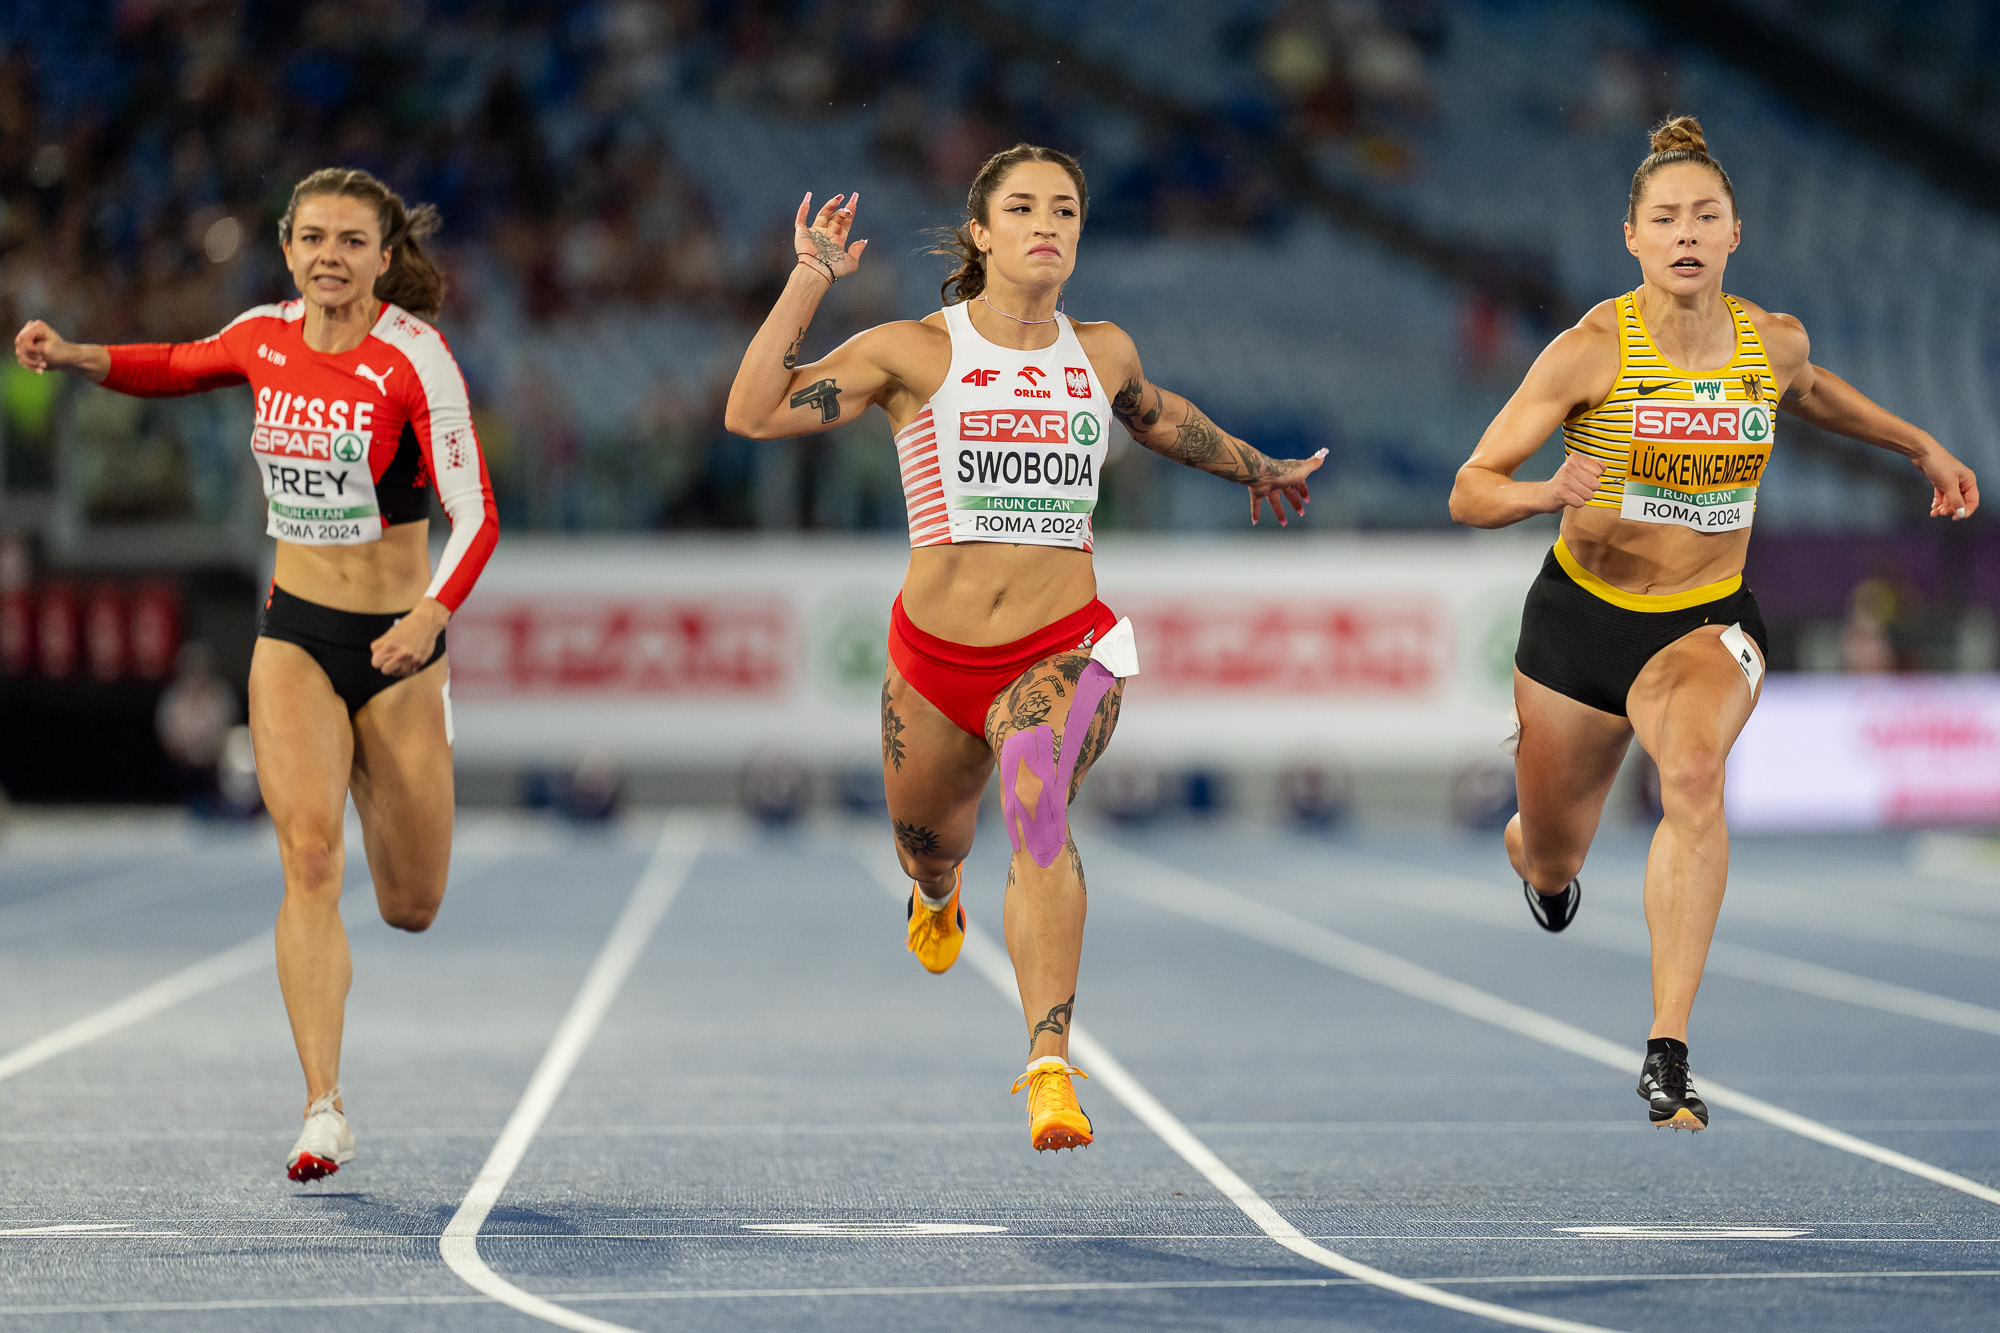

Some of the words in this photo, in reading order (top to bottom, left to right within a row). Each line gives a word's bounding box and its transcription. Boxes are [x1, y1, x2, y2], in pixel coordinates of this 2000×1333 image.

[267, 349, 287, 366] UBS
[961, 368, 1001, 387] 4F
[1013, 388, 1051, 399] ORLEN
[963, 413, 1066, 439] SPAR
[1638, 410, 1737, 436] SPAR
[254, 426, 330, 458] SPAR
[957, 449, 1093, 487] SWOBODA
[1631, 446, 1765, 486] LÜCKENKEMPER
[268, 463, 349, 498] FREY
[993, 498, 1025, 510] RUN
[1663, 489, 1693, 503] RUN
[975, 515, 1037, 533] ROMA
[1041, 517, 1083, 534] 2024
[1643, 501, 1703, 526] ROMA
[1707, 507, 1741, 526] 2024
[319, 523, 360, 539] 2024
